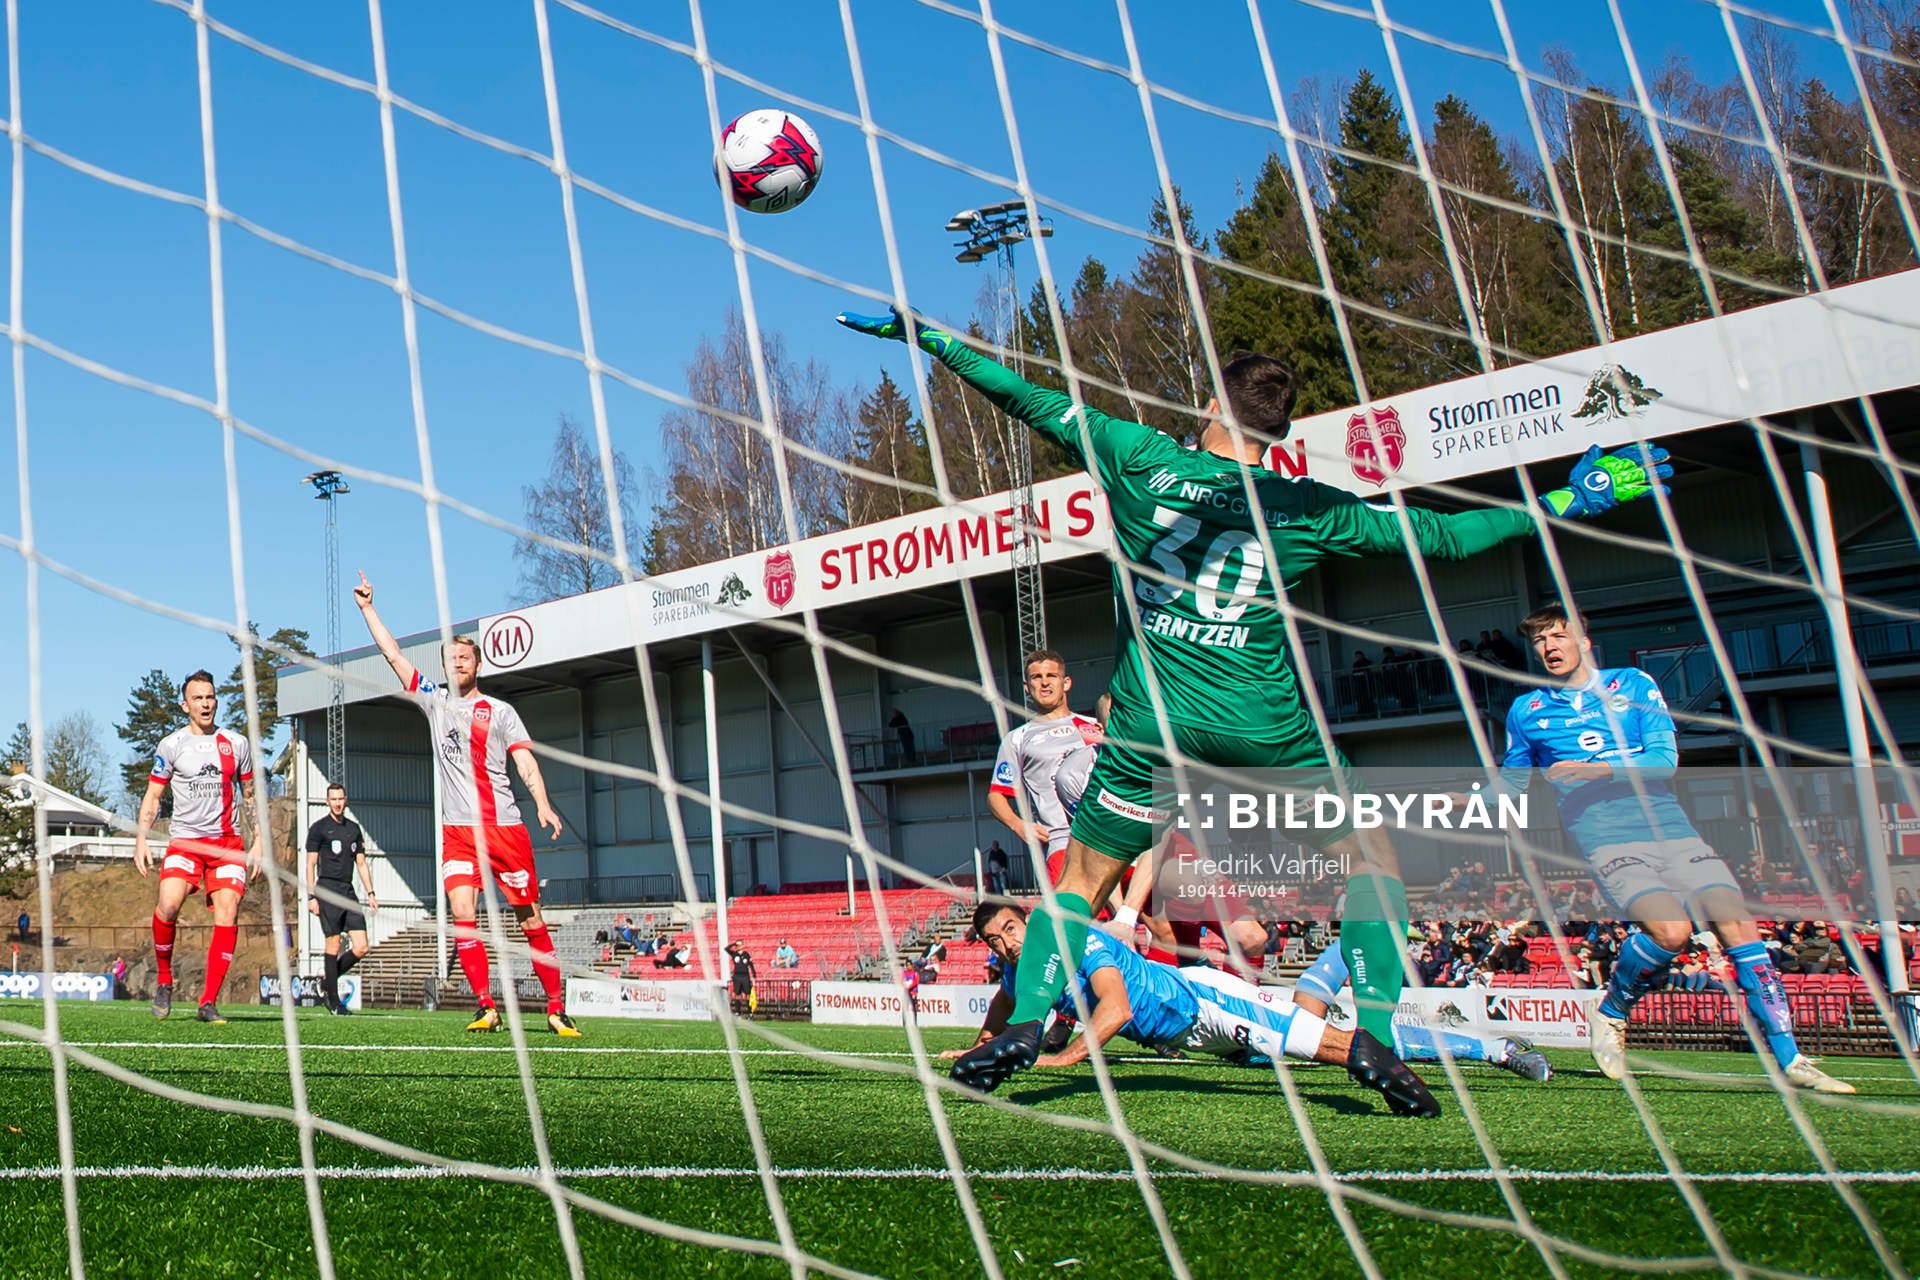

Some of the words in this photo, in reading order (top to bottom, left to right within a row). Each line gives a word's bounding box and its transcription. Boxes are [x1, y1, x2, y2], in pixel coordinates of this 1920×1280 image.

[1429, 383, 1562, 433] Strømmen
[1351, 422, 1397, 443] STRØMEN
[1432, 412, 1565, 459] SPAREBANK
[1180, 481, 1227, 509] NRC
[1230, 497, 1289, 527] Grup
[820, 499, 1052, 590] STRØMMEN
[1135, 505, 1265, 623] 30
[652, 602, 711, 627] SPAREBANK
[1138, 607, 1250, 649] ERNTZEN
[492, 626, 525, 658] KIA
[1101, 793, 1146, 819] Romerikes
[1043, 953, 1062, 985] umbro
[1351, 948, 1367, 984] umbro
[0, 975, 40, 999] oop
[51, 973, 109, 1001] coop
[815, 993, 877, 1011] STRØMMEN
[881, 997, 951, 1014] STOENTER
[968, 998, 988, 1014] OB
[1507, 999, 1588, 1022] NETELAN
